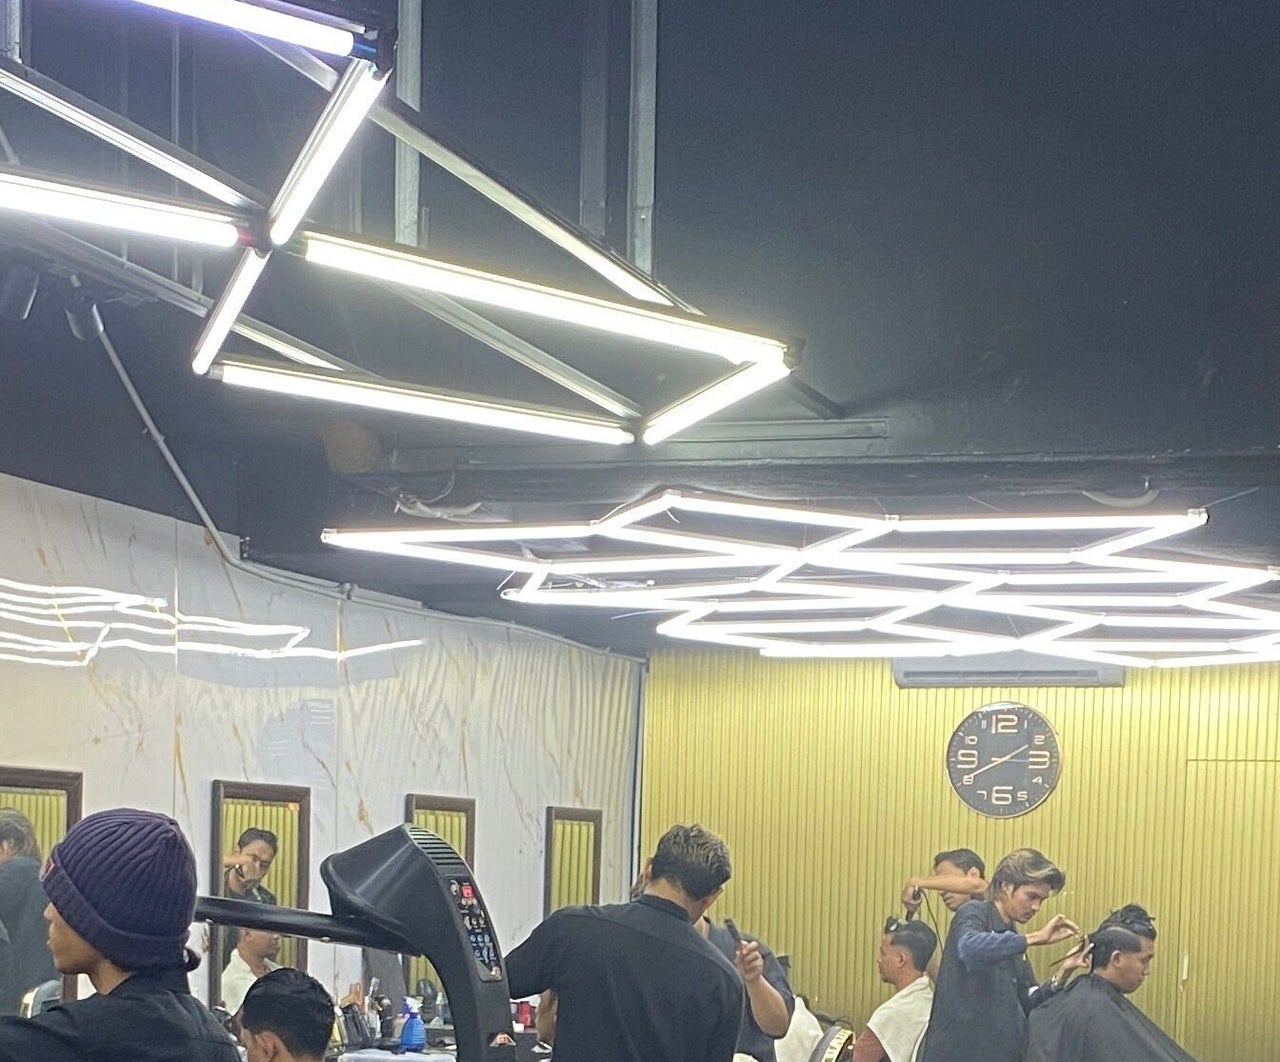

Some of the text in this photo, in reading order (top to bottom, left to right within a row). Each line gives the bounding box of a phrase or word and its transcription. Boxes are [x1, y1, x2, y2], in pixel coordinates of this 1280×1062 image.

[981, 719, 987, 729] 11
[991, 714, 1019, 734] 12
[1034, 735, 1046, 745] 2
[957, 750, 979, 769] 9
[1028, 750, 1051, 769] 3
[962, 775, 974, 785] 8
[1032, 776, 1043, 785] 4
[976, 791, 988, 801] 7
[991, 786, 1014, 805] 6
[1016, 791, 1028, 801] 5
